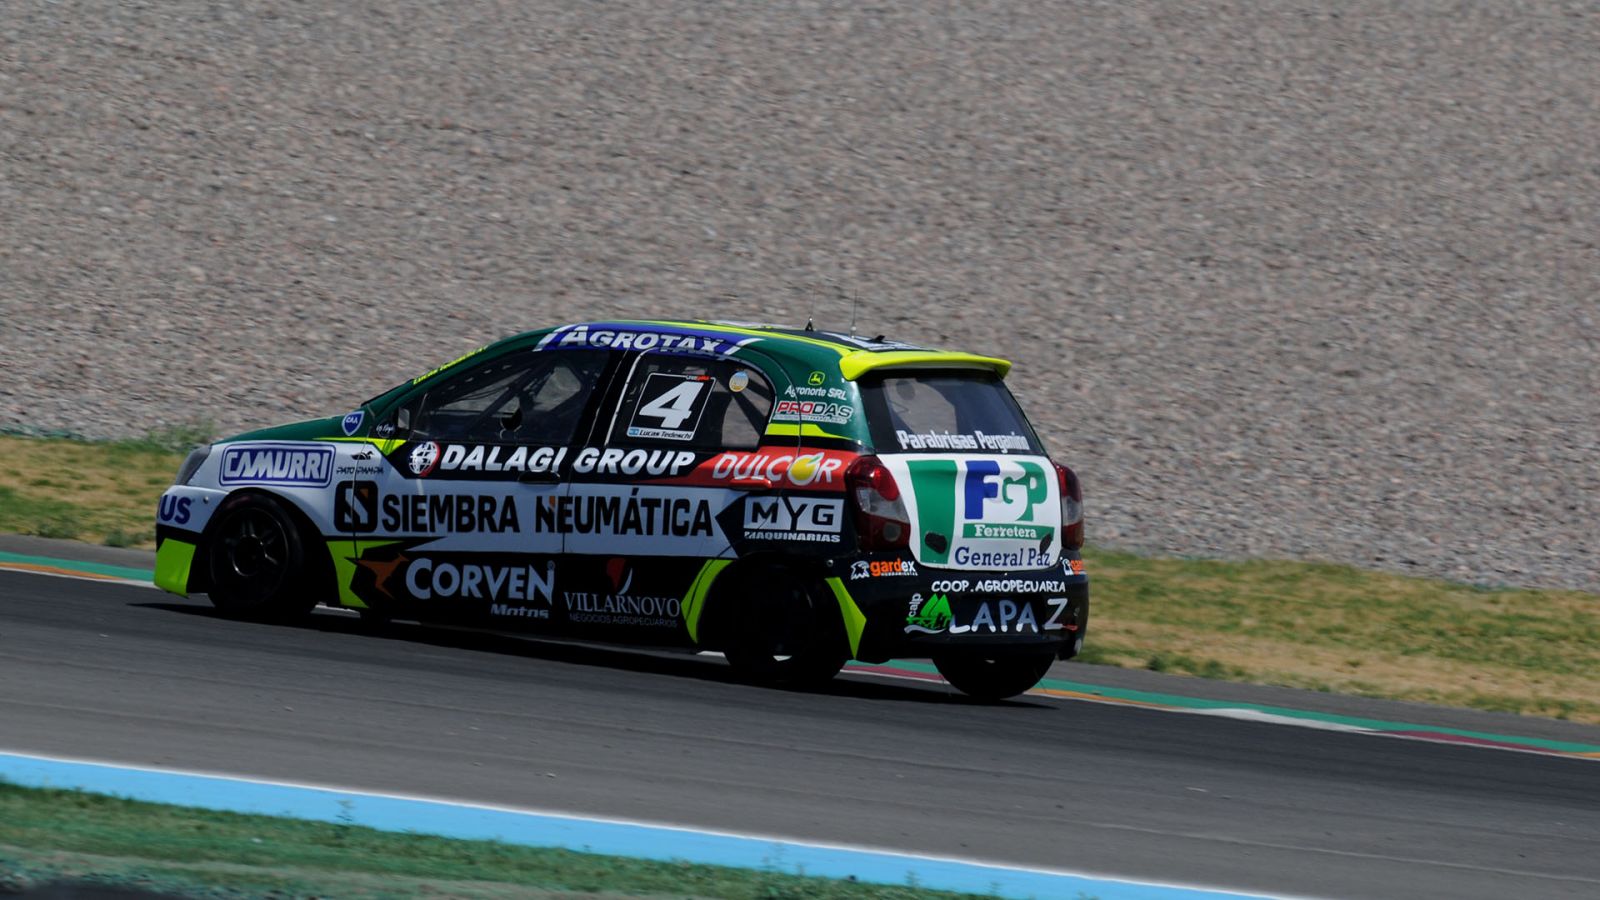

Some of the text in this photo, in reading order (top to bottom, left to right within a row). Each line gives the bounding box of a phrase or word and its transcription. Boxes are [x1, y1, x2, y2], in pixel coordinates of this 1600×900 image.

[558, 325, 725, 354] AGROTAX
[638, 381, 705, 429] 4
[784, 385, 847, 401] Agronorte SRL
[776, 401, 853, 419] PRODAS
[896, 429, 1031, 453] Parabrisas Pergamino
[223, 449, 331, 481] CAMURRI
[439, 444, 696, 476] DALAGI GROUP
[964, 460, 1048, 522] FGP
[382, 488, 714, 537] SIEMBRA NEUMÁTICA
[751, 497, 835, 531] MYG
[744, 531, 841, 543] MAQUINARIAS
[973, 523, 1038, 539] Ferretera
[869, 557, 916, 577] gardex
[954, 546, 1051, 567] General Paz
[404, 557, 556, 606] CORVEN
[490, 603, 550, 619] Motos
[563, 591, 681, 617] VILLARNOVO
